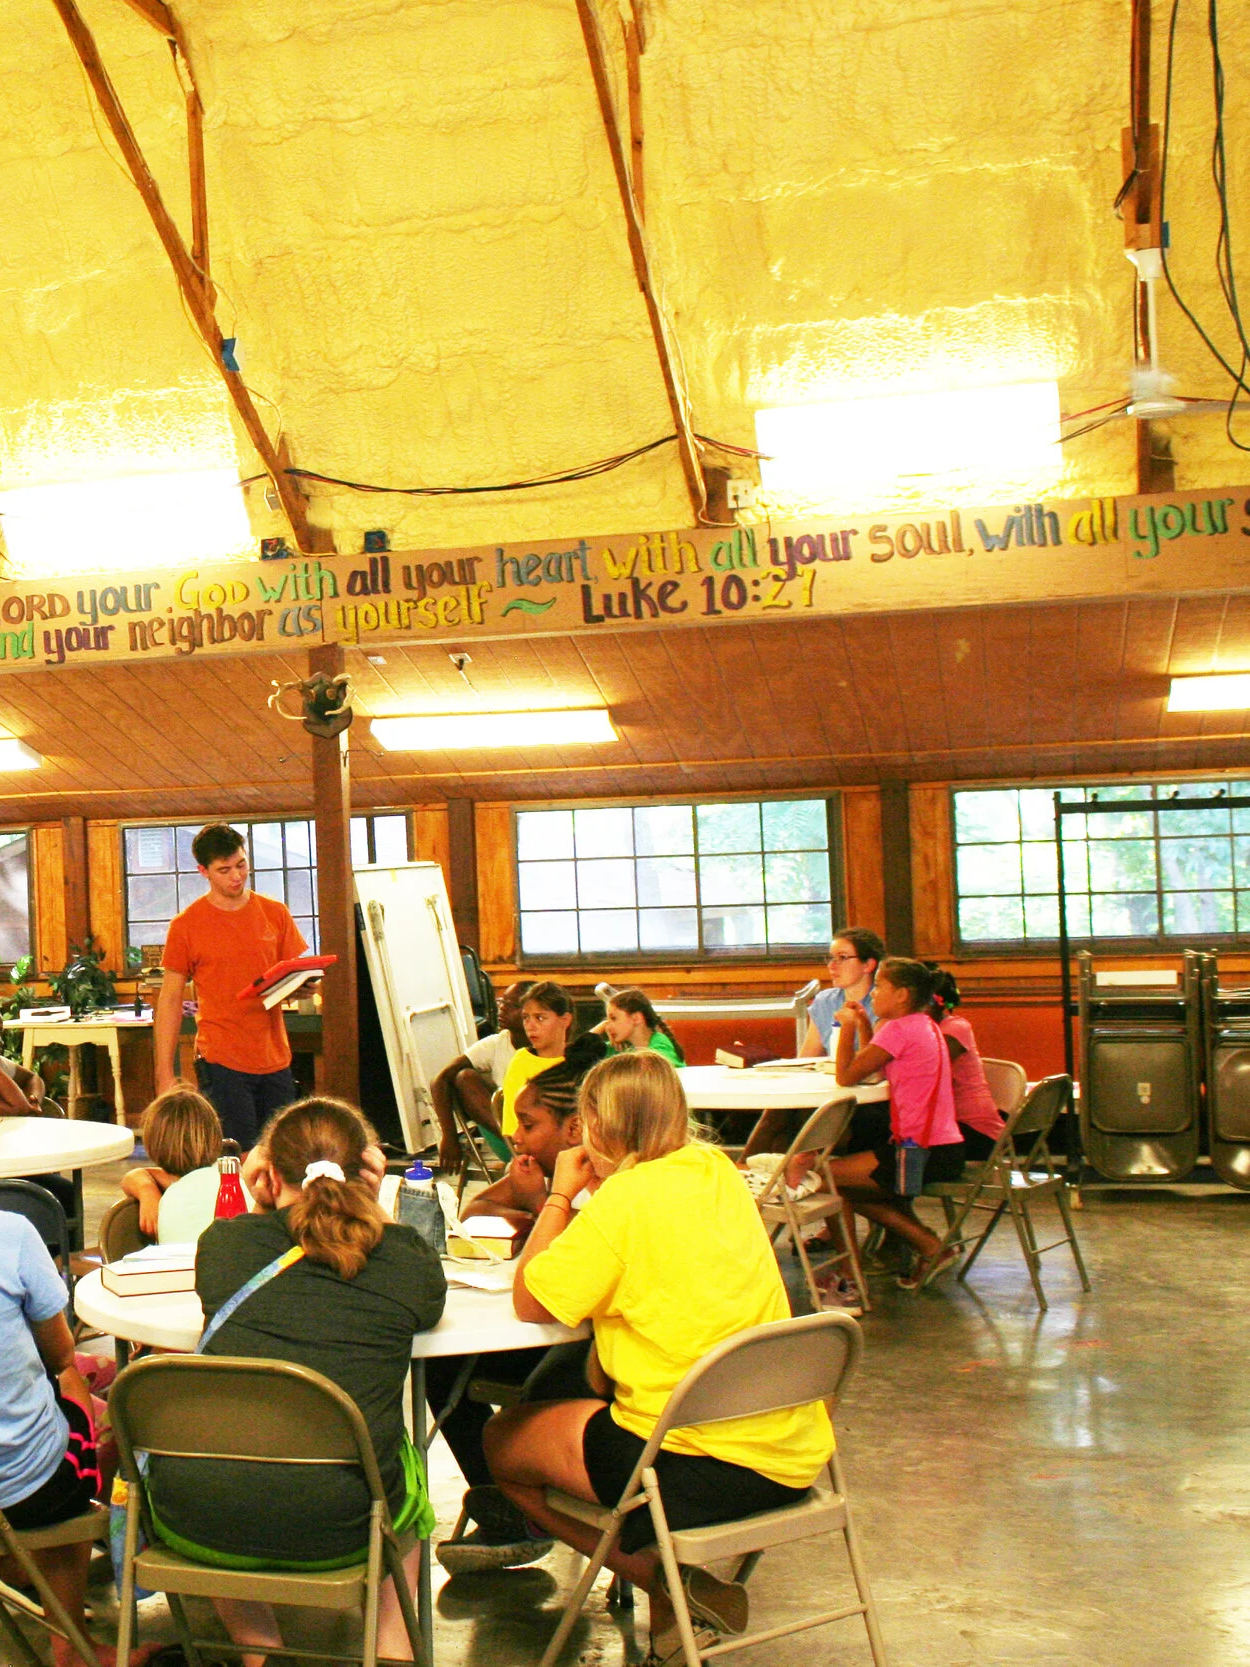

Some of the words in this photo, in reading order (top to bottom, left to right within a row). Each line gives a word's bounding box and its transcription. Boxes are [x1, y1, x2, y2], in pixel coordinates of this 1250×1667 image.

[43, 626, 115, 664] your
[128, 607, 273, 655] neighbor
[278, 605, 322, 637] as
[335, 581, 492, 645] yourself
[581, 577, 688, 624] Luke
[701, 568, 817, 616] 10:27
[76, 582, 160, 626] your
[254, 561, 339, 602] with
[346, 556, 391, 596] all
[402, 556, 482, 600] your
[602, 532, 702, 579] with
[710, 528, 759, 572] all
[768, 529, 858, 582] your
[868, 510, 974, 563] soul,
[974, 503, 1062, 552] with
[1067, 497, 1119, 546] all
[1128, 498, 1235, 559] your
